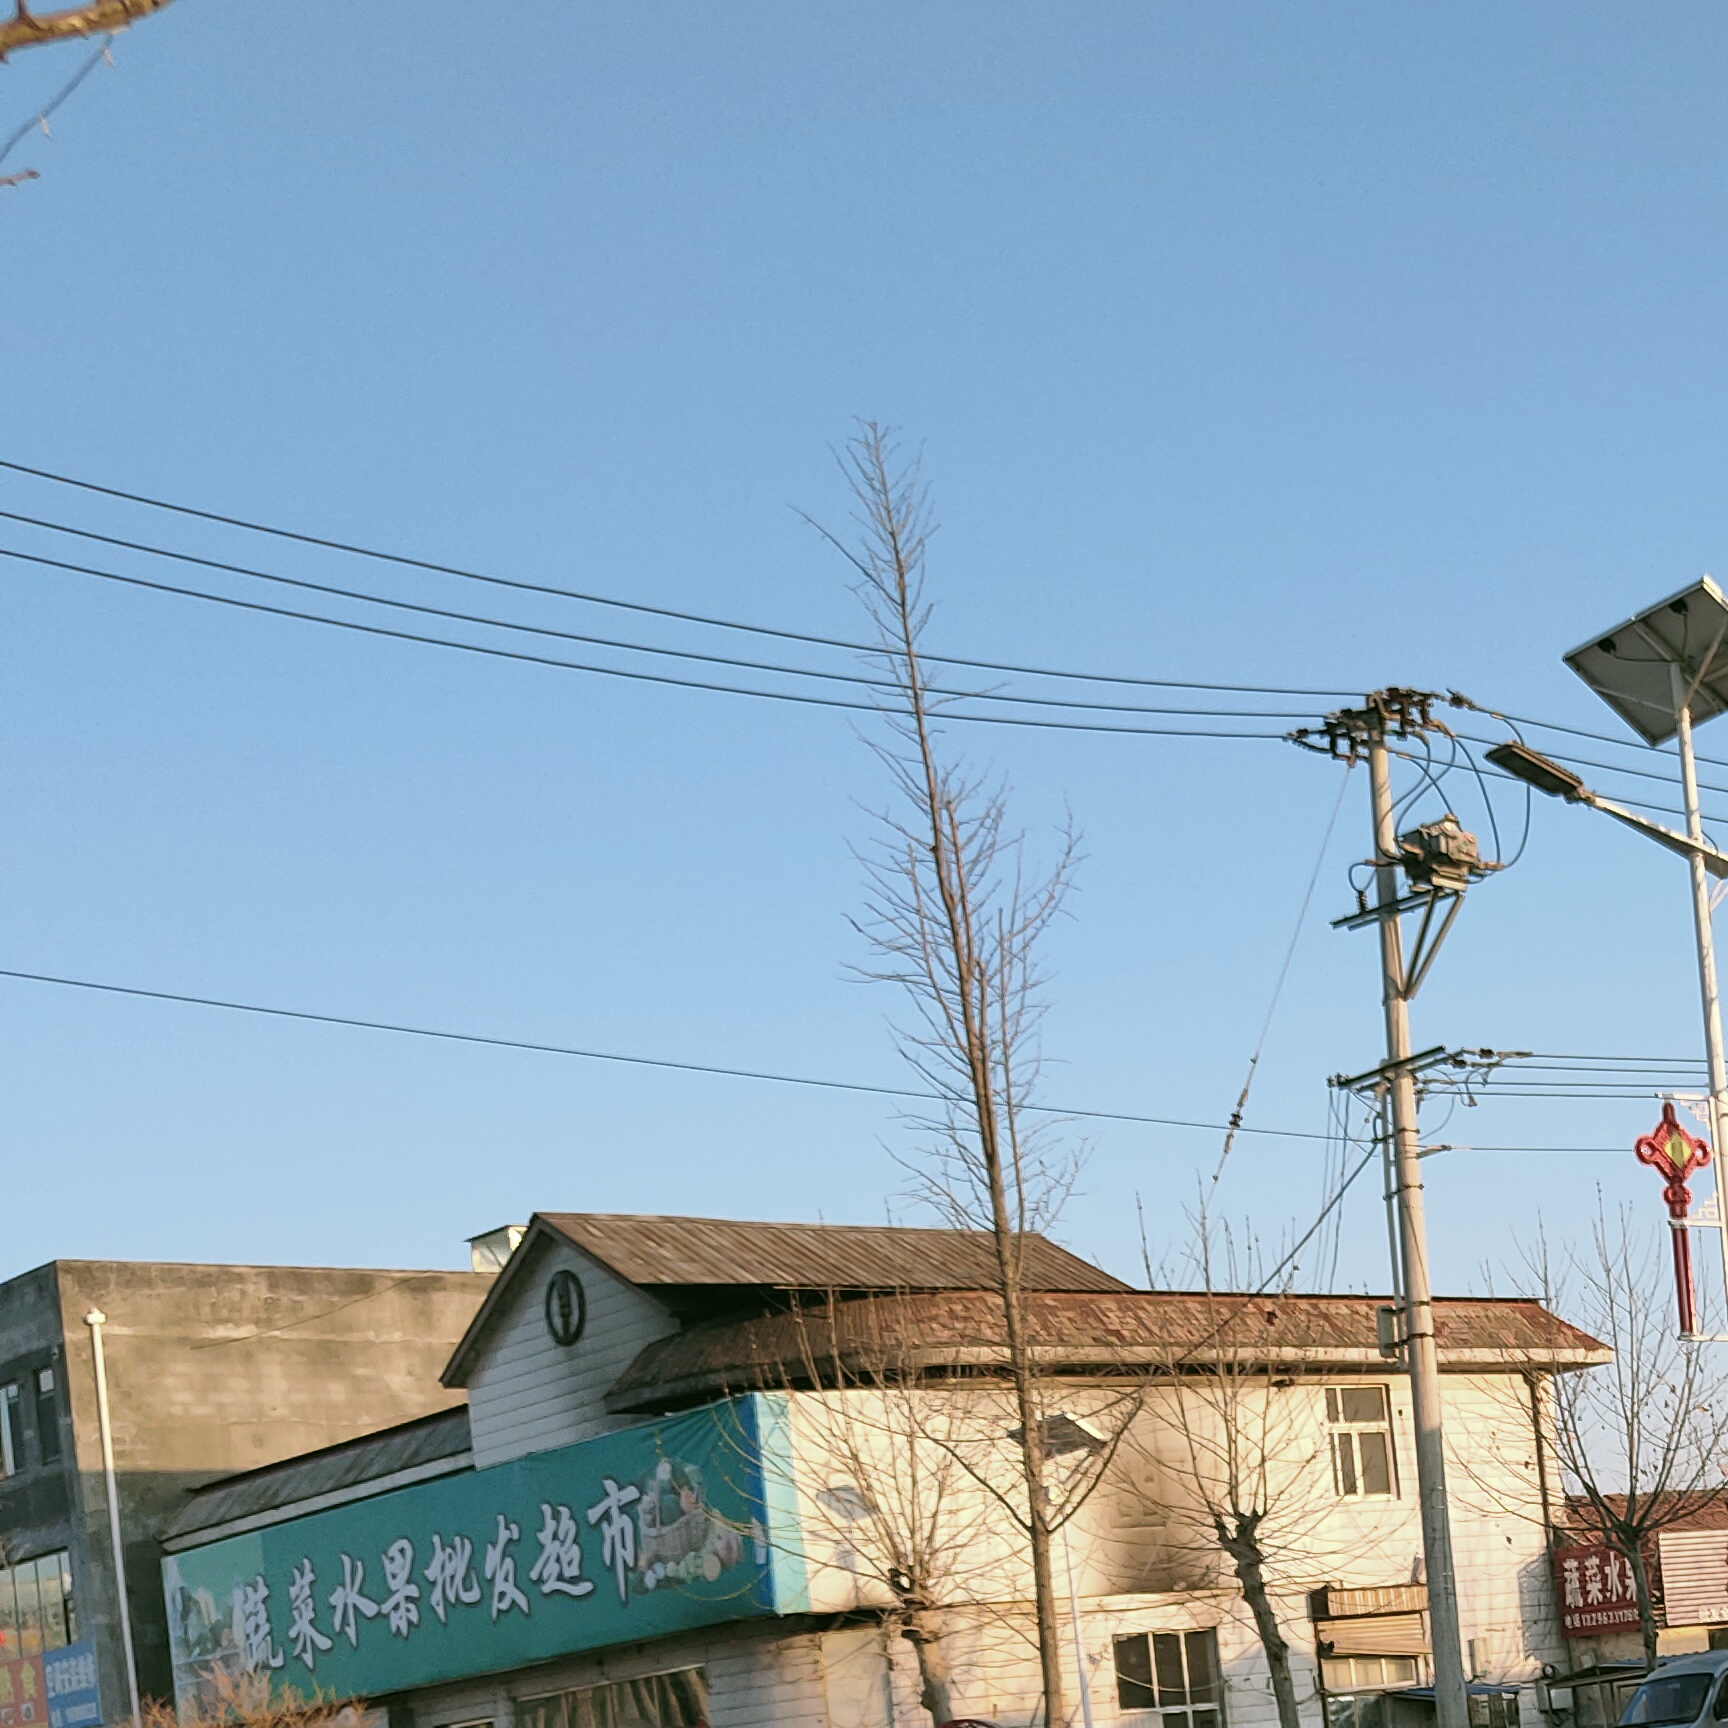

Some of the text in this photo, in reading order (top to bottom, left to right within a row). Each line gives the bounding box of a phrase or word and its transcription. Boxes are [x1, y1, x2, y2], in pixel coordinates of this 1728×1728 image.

[232, 1479, 641, 1671] 蔬菜水果批发超市
